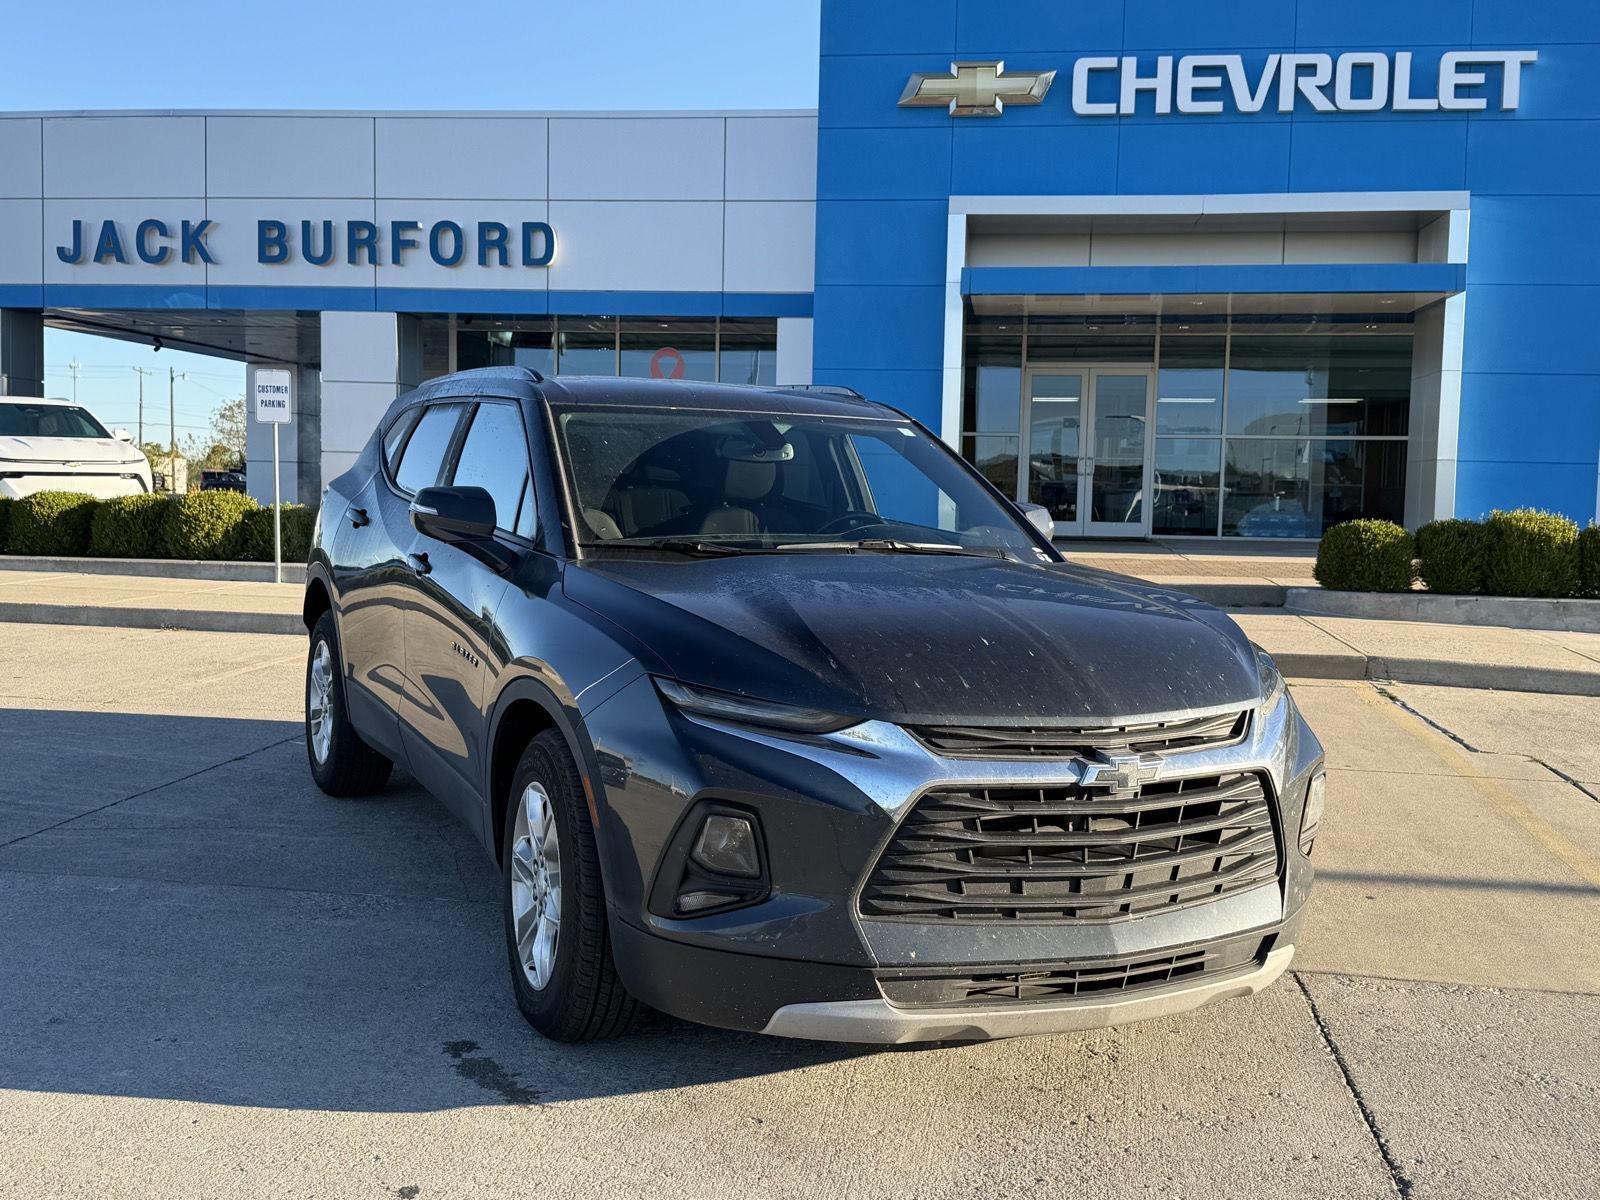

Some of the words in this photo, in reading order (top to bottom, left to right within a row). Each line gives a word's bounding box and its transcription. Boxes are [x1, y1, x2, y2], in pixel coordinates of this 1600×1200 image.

[1072, 50, 1538, 116] CHEVROLET
[56, 219, 216, 265] JACK
[257, 219, 555, 267] BURFORD
[257, 384, 289, 394] CUSTOMER
[260, 399, 286, 409] PARKING
